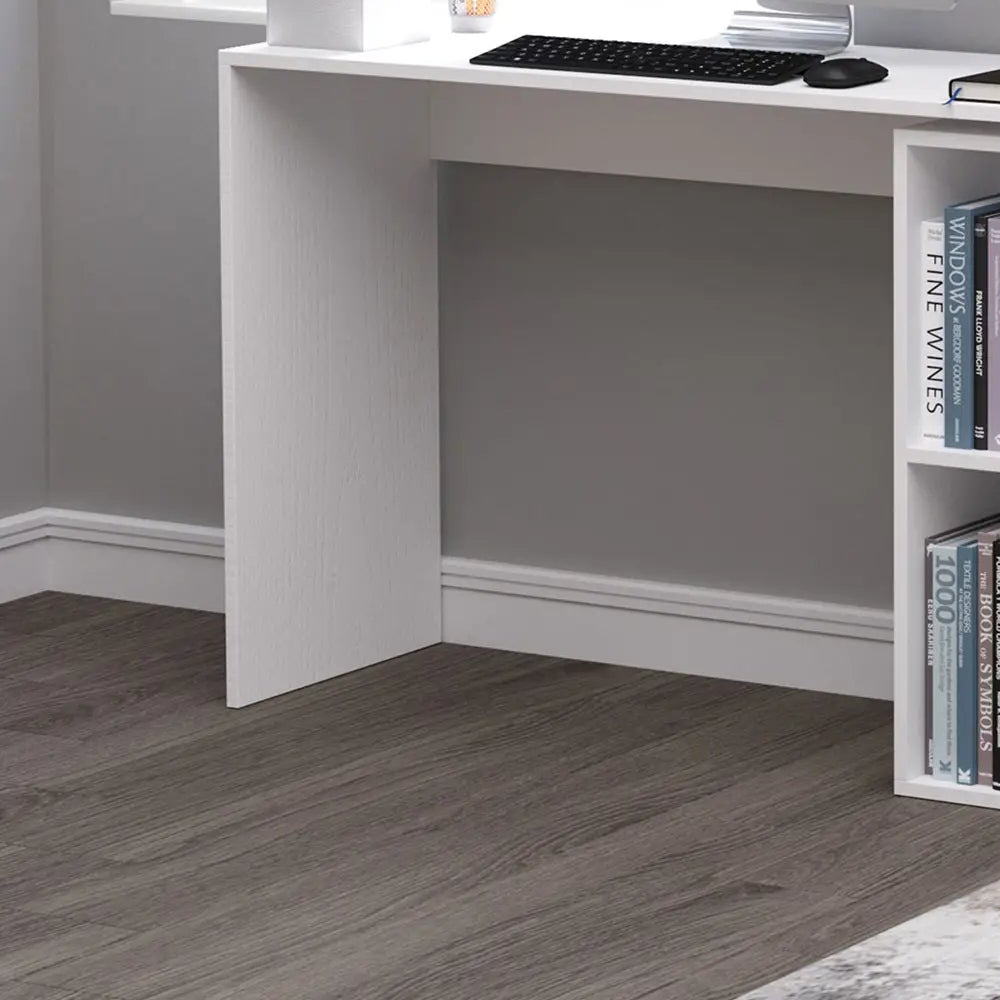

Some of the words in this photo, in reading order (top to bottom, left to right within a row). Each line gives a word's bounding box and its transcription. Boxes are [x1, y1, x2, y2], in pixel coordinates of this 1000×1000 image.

[926, 253, 944, 313] FINE
[949, 216, 966, 314] WINDOWS
[975, 290, 983, 317] FRANK
[975, 318, 983, 343] LLOYD
[926, 326, 944, 414] WINES
[975, 344, 983, 376] WRIGHT
[935, 556, 956, 625] 1000
[963, 560, 972, 590] TEXTILE
[963, 591, 972, 633] DESIGNERS
[980, 593, 993, 643] BOOK
[980, 663, 993, 751] SYMBOLS
